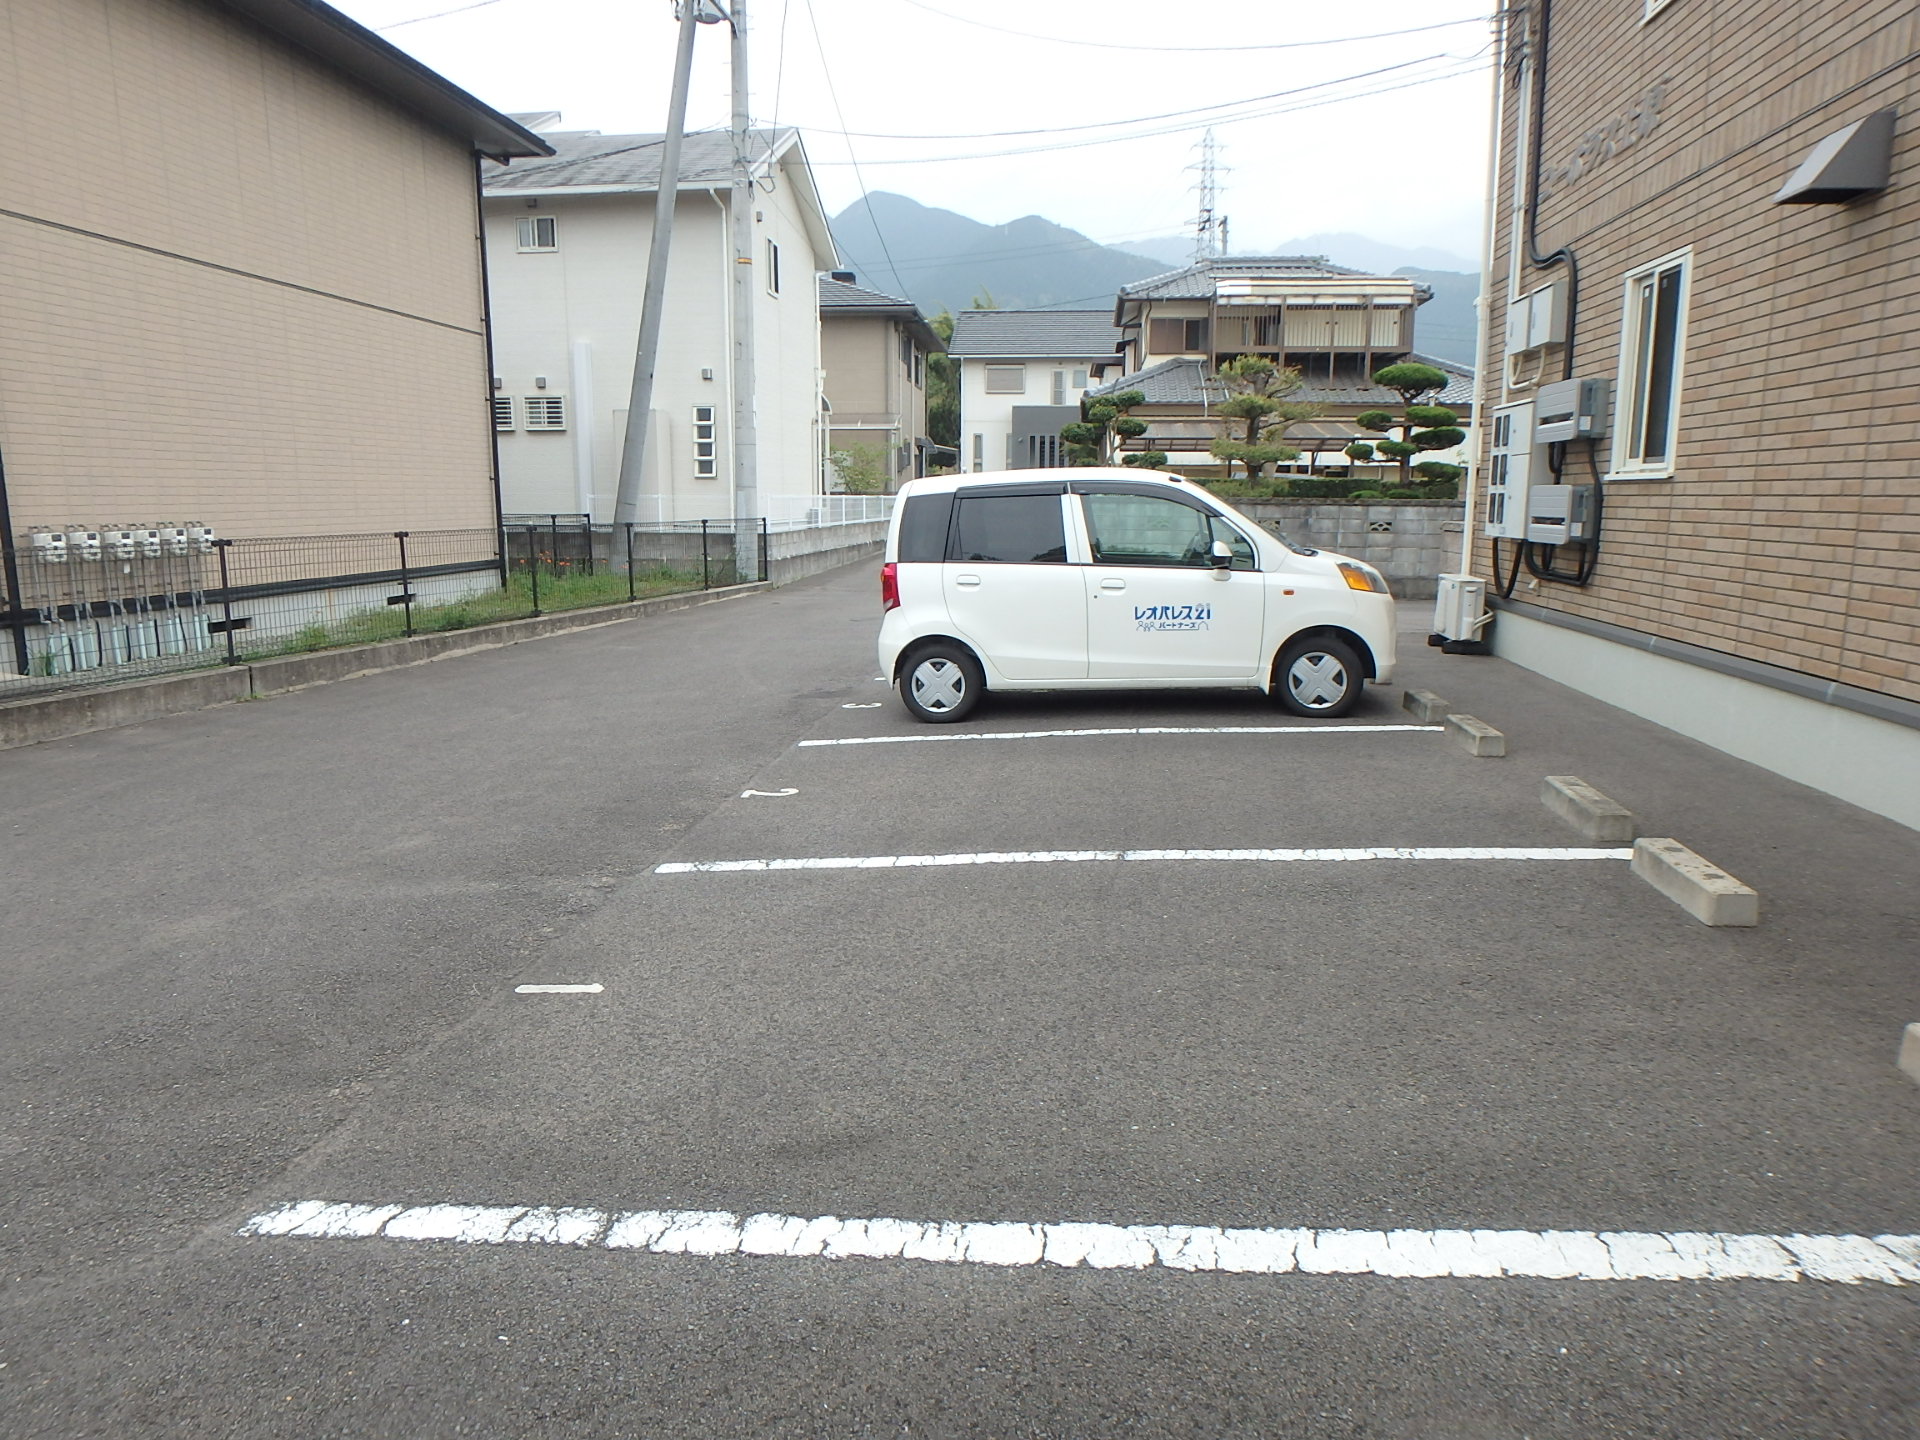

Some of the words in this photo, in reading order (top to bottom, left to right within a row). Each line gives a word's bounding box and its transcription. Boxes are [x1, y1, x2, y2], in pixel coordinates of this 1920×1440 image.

[1135, 603, 1211, 620] レオパレス21
[740, 788, 799, 799] 2
